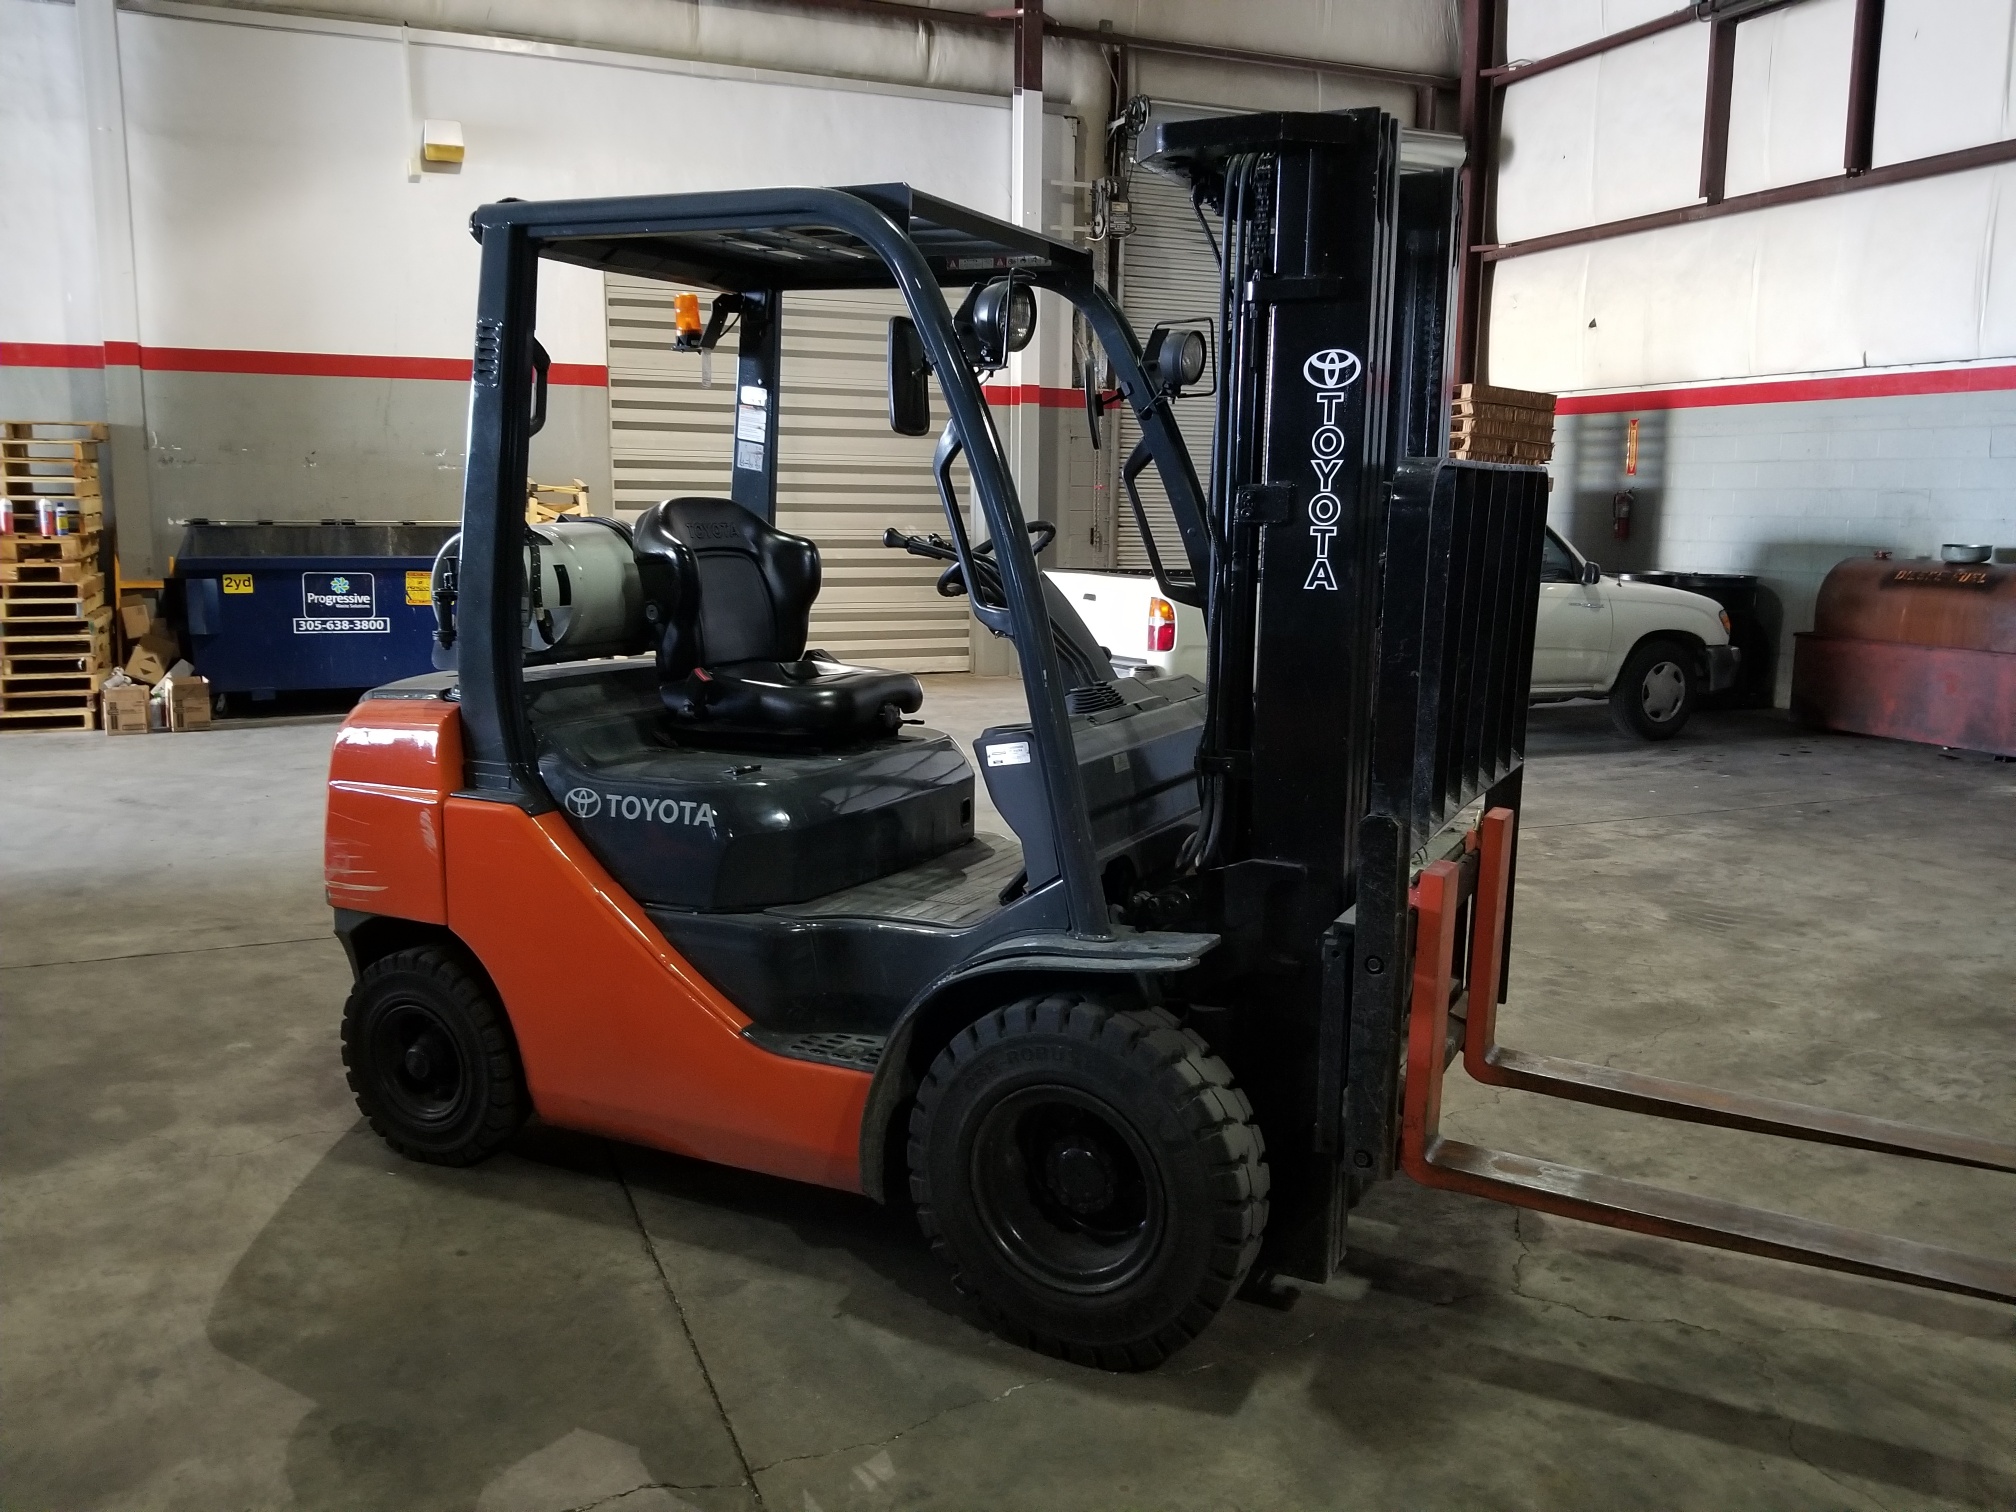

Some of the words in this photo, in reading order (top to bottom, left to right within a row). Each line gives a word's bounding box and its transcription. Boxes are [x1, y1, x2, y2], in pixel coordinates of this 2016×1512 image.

[1303, 391, 1344, 591] TOYOTA
[686, 523, 739, 538] TOYOTA
[224, 577, 252, 590] 2yd
[307, 592, 371, 606] Progressive
[299, 620, 384, 631] 305-638-3800
[606, 794, 716, 828] TOYOTA
